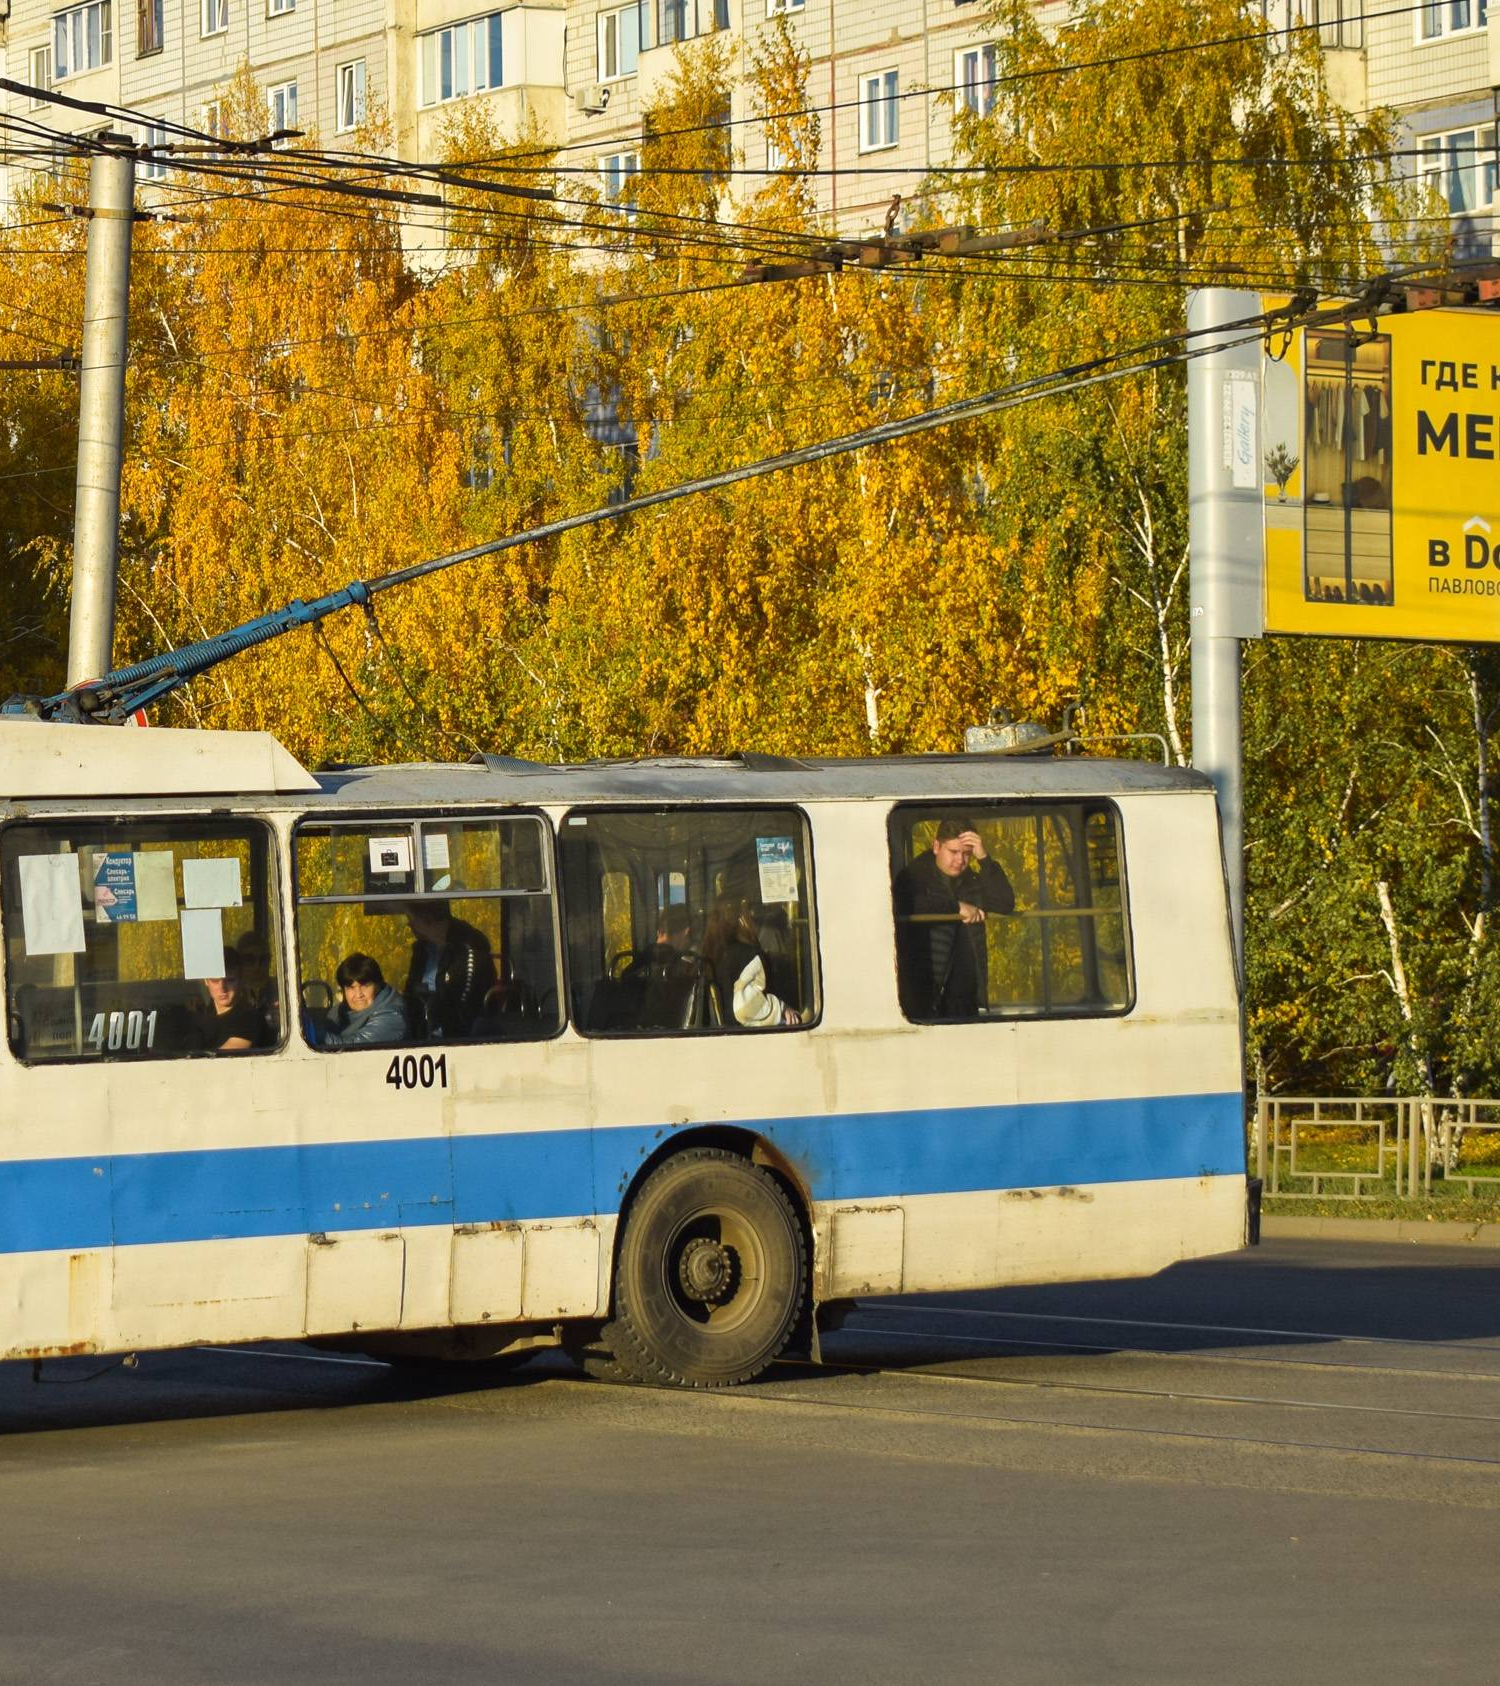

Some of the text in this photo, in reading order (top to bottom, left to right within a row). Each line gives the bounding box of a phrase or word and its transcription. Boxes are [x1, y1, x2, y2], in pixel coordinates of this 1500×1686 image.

[1421, 360, 1478, 392] ГДЕ
[1236, 404, 1255, 465] Gallery
[1417, 410, 1500, 460] МЕ
[88, 1010, 157, 1050] 4001
[386, 1053, 447, 1090] 4001
